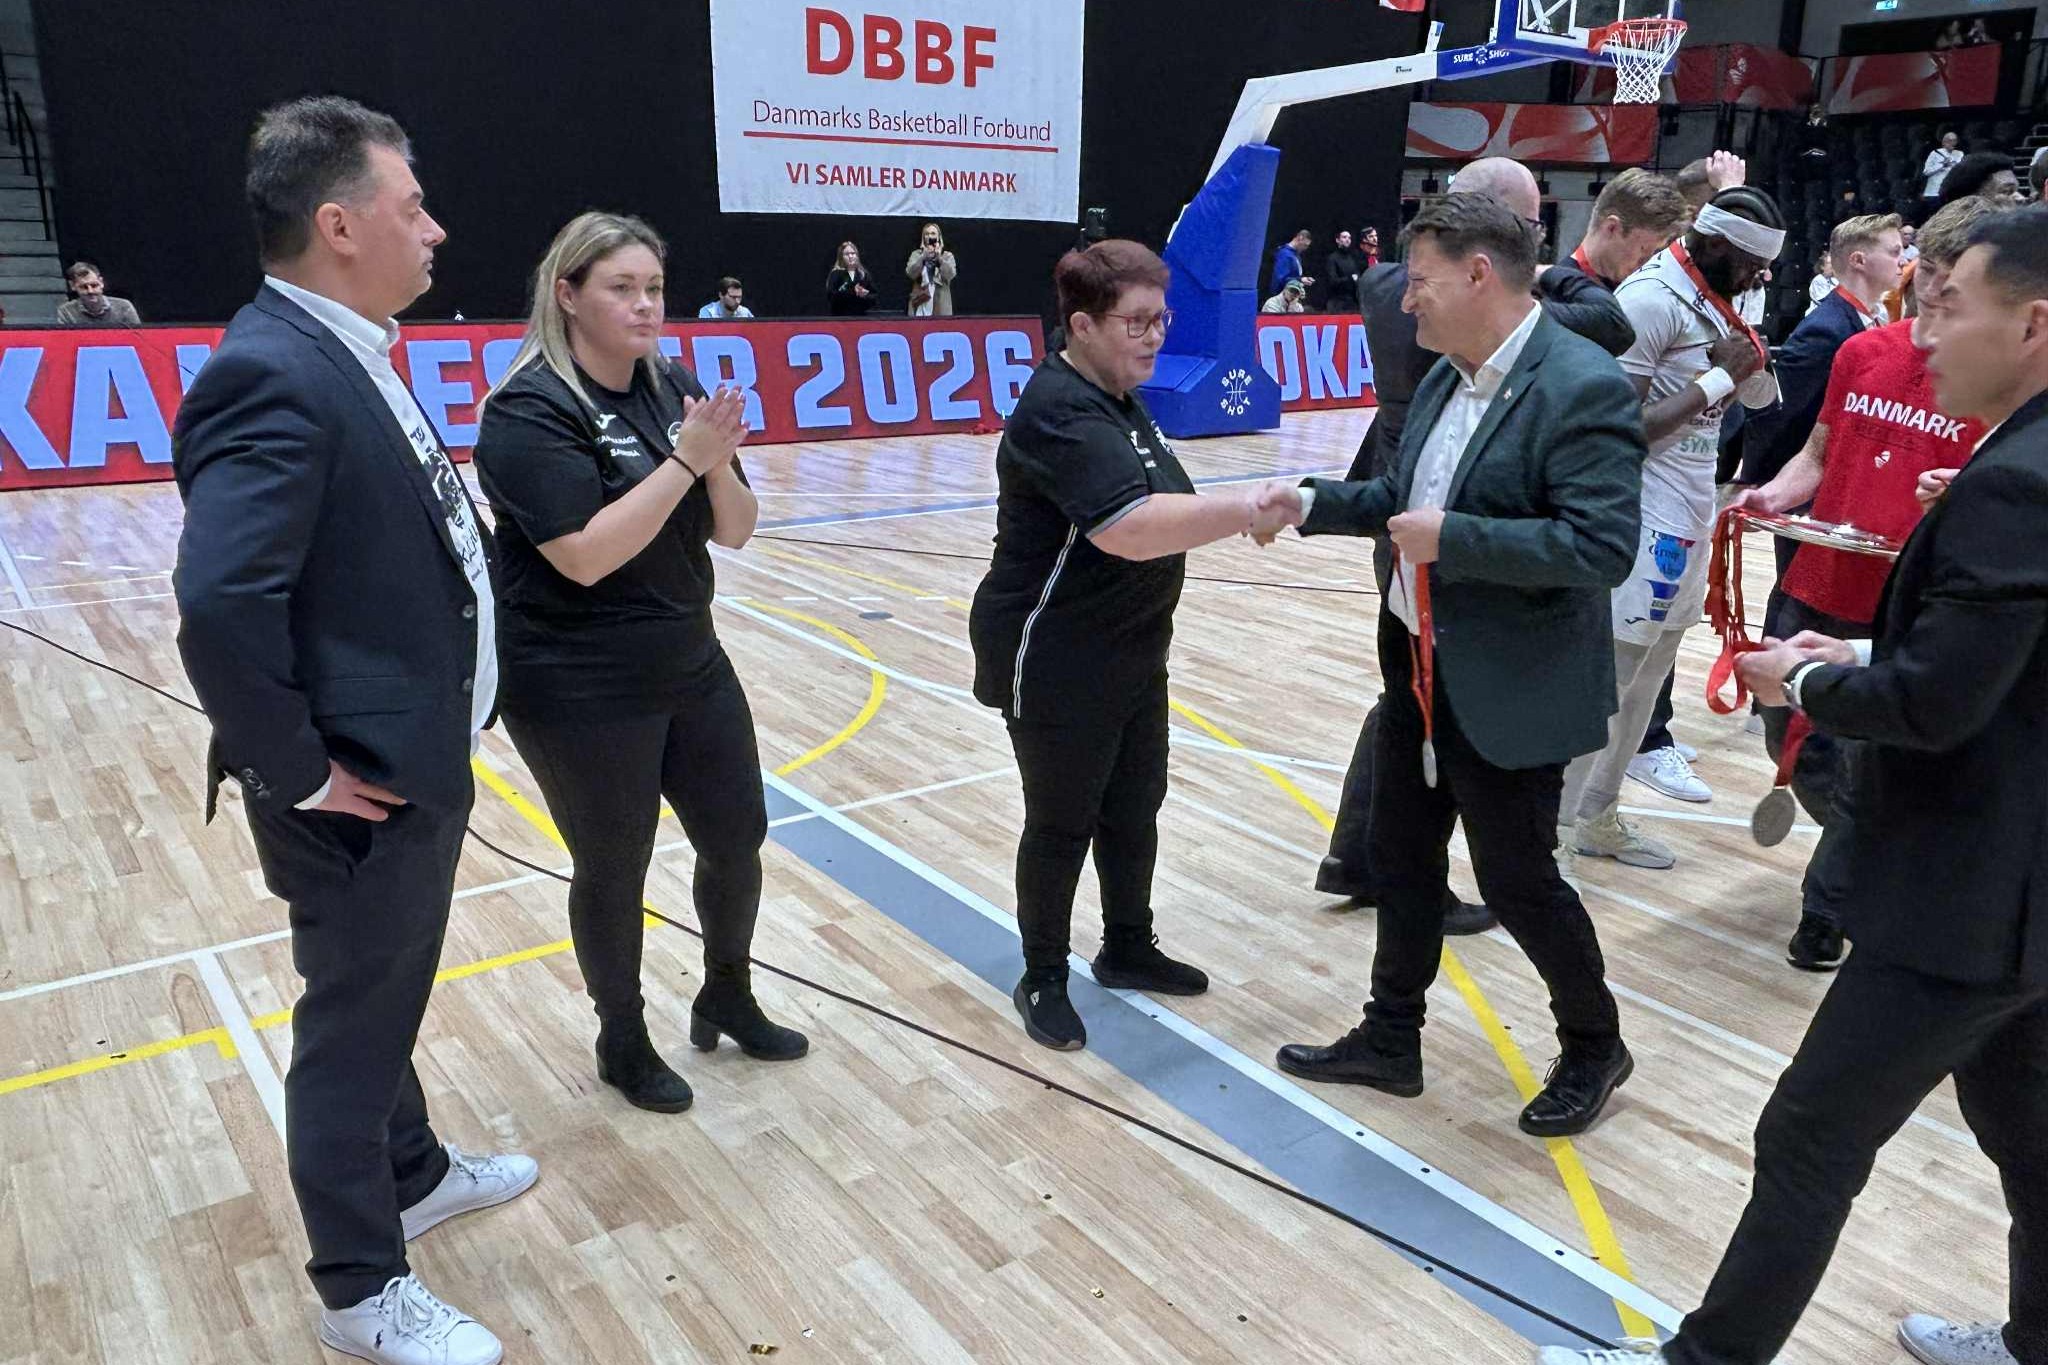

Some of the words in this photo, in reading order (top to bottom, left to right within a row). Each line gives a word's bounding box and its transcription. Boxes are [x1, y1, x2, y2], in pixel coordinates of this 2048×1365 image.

[806, 7, 997, 88] DBBF
[1453, 52, 1474, 64] SURE
[754, 100, 862, 131] Danmarks
[869, 109, 968, 138] Basketball
[974, 116, 1051, 142] Forbund
[786, 162, 809, 186] VI
[816, 163, 907, 189] SAMLER
[912, 168, 1018, 194] DANMARK
[787, 330, 1035, 428] 2026
[1221, 368, 1253, 387] SURE
[1220, 396, 1251, 416] SHOT
[1843, 392, 1967, 442] DANMARK
